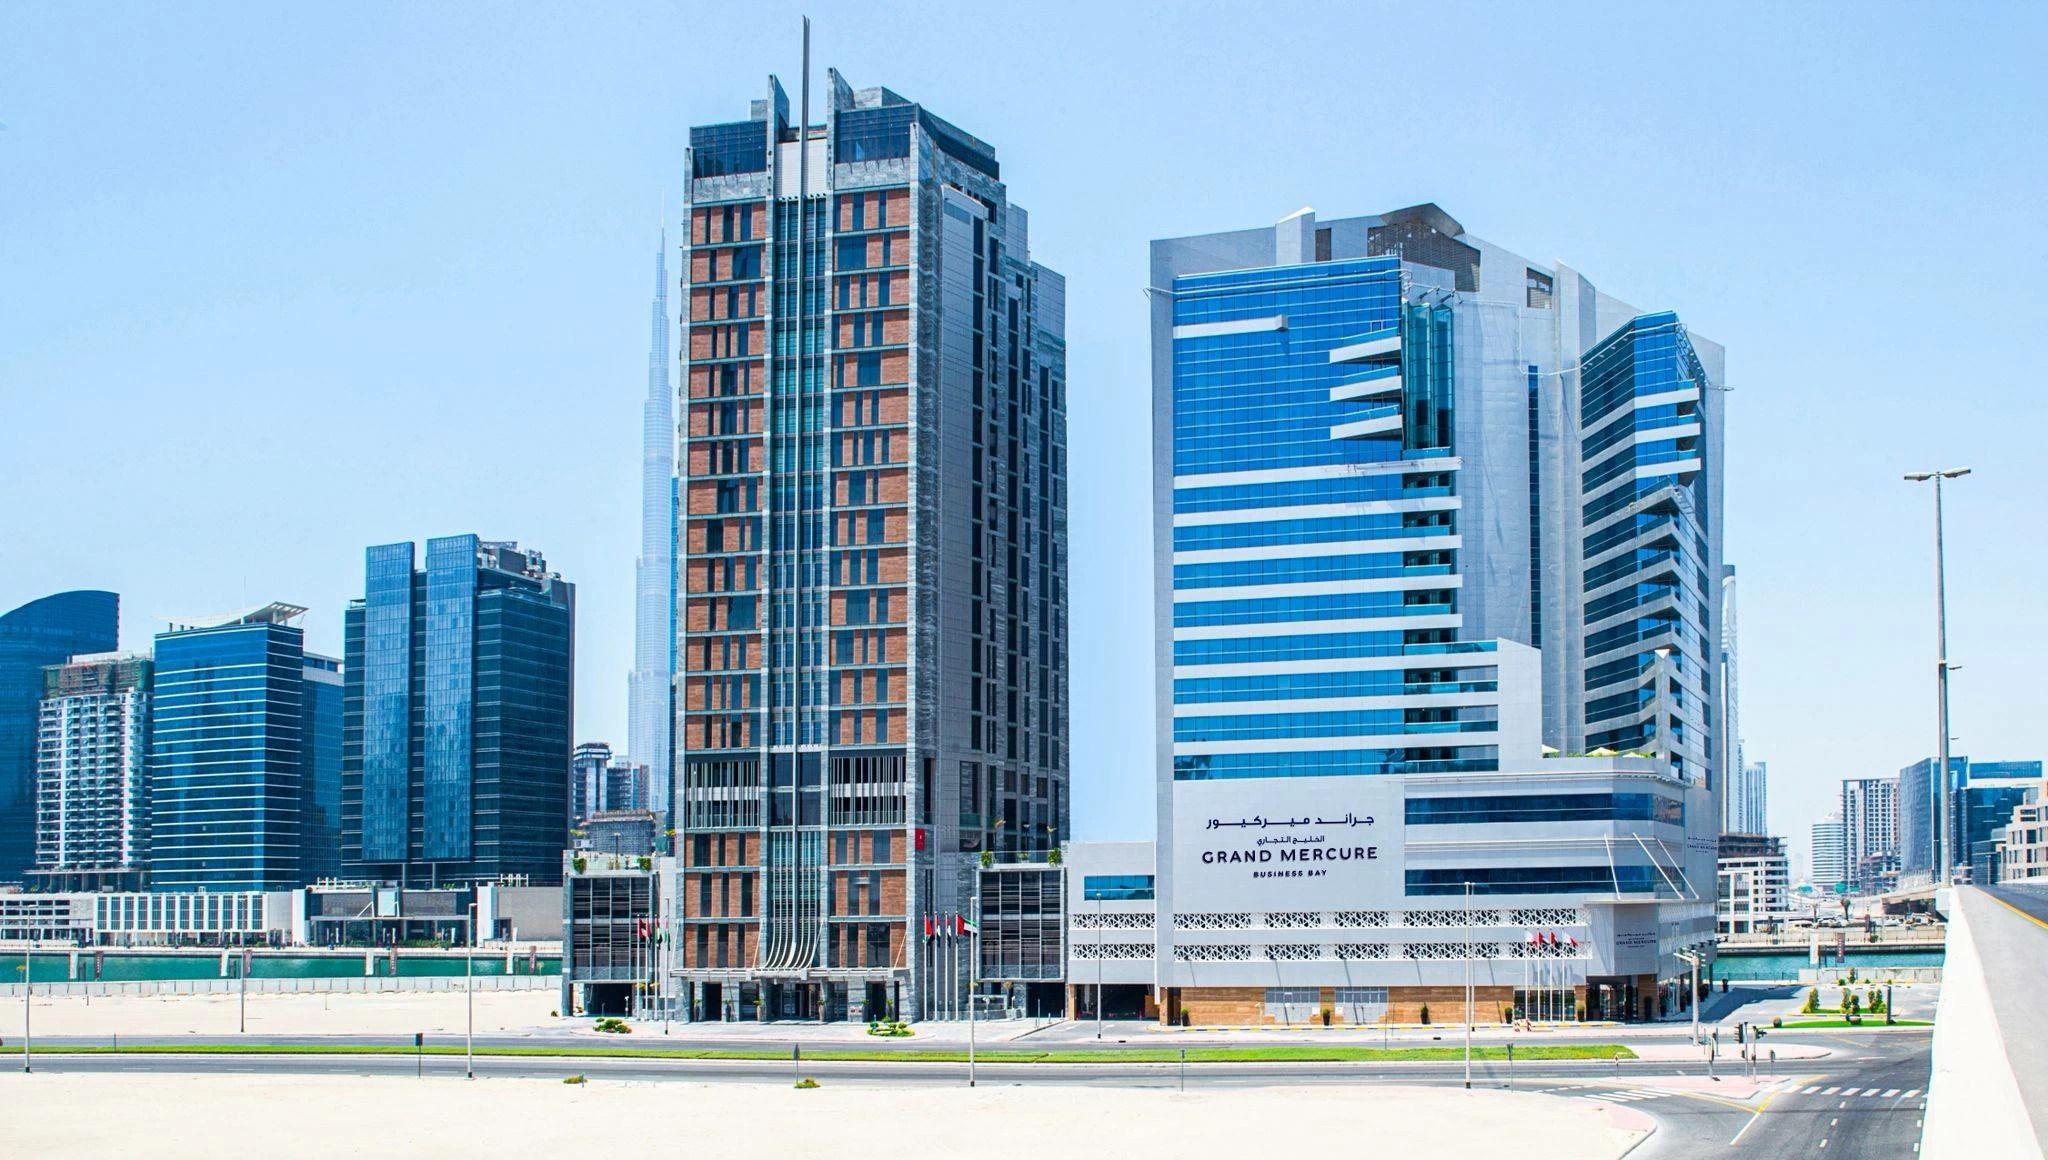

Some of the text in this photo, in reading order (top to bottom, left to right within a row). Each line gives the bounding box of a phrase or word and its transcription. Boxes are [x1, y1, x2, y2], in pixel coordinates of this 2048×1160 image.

[1206, 812, 1375, 829] جراند ميركيور
[1256, 835, 1325, 847] الخليج التجاري
[1202, 846, 1378, 864] GRAND MERCURE
[1253, 869, 1327, 878] BUSINESS BAY
